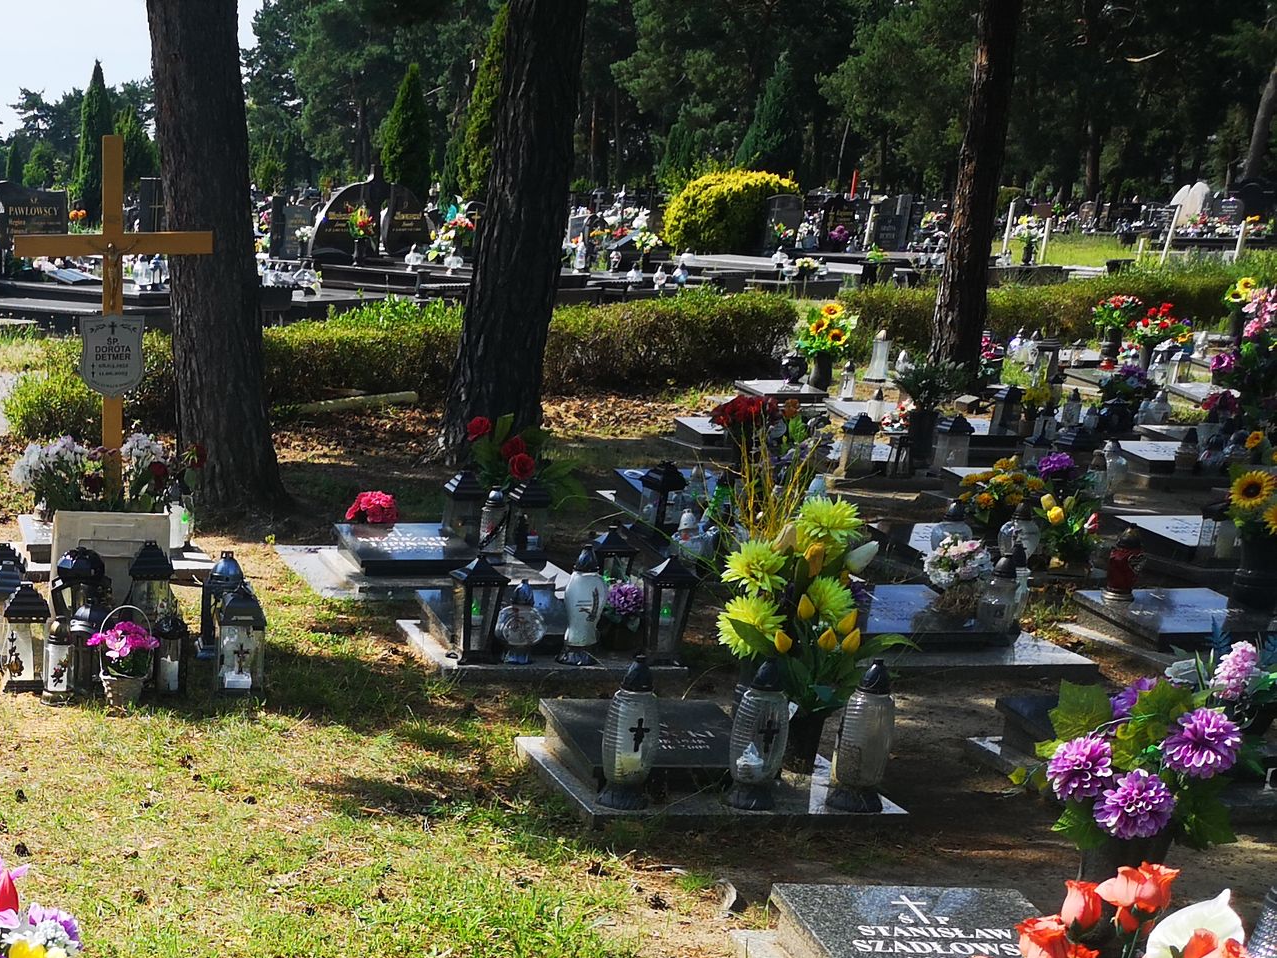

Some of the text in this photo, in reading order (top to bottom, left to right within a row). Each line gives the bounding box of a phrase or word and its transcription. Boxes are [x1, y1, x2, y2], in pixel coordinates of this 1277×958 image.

[94, 345, 132, 353] DOROTA
[95, 353, 132, 361] DETMER
[933, 916, 950, 925] P
[857, 925, 1013, 940] STANISŁAW
[852, 939, 1022, 957] SZADŁOWS
